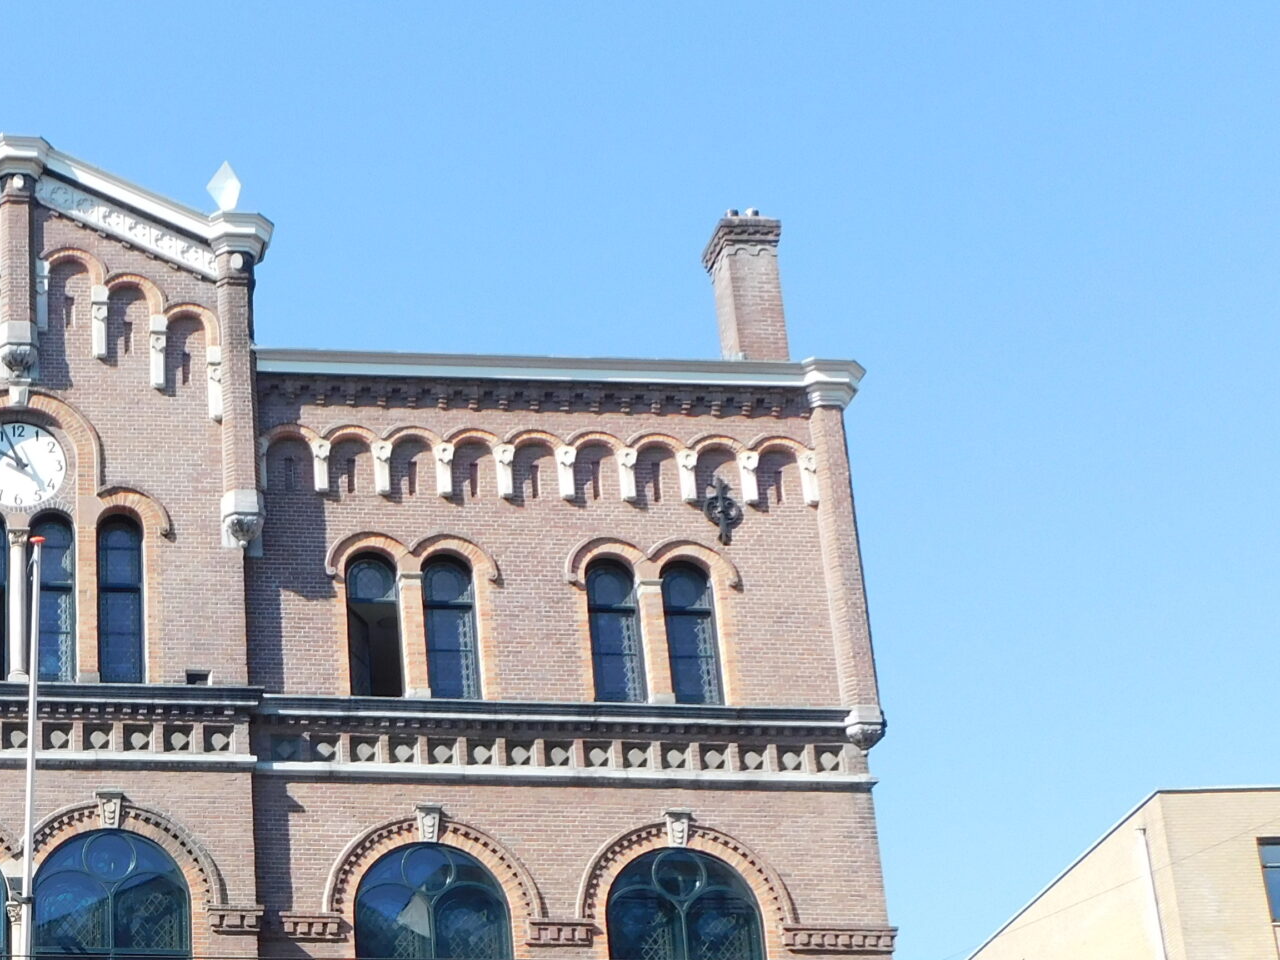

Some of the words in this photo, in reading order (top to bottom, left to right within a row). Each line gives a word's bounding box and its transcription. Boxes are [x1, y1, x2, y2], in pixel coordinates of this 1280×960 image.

[11, 425, 25, 438] 12
[47, 442, 56, 454] 2
[55, 460, 63, 472] 3
[46, 478, 55, 491] 4
[14, 493, 23, 506] 6
[34, 489, 42, 502] 5
